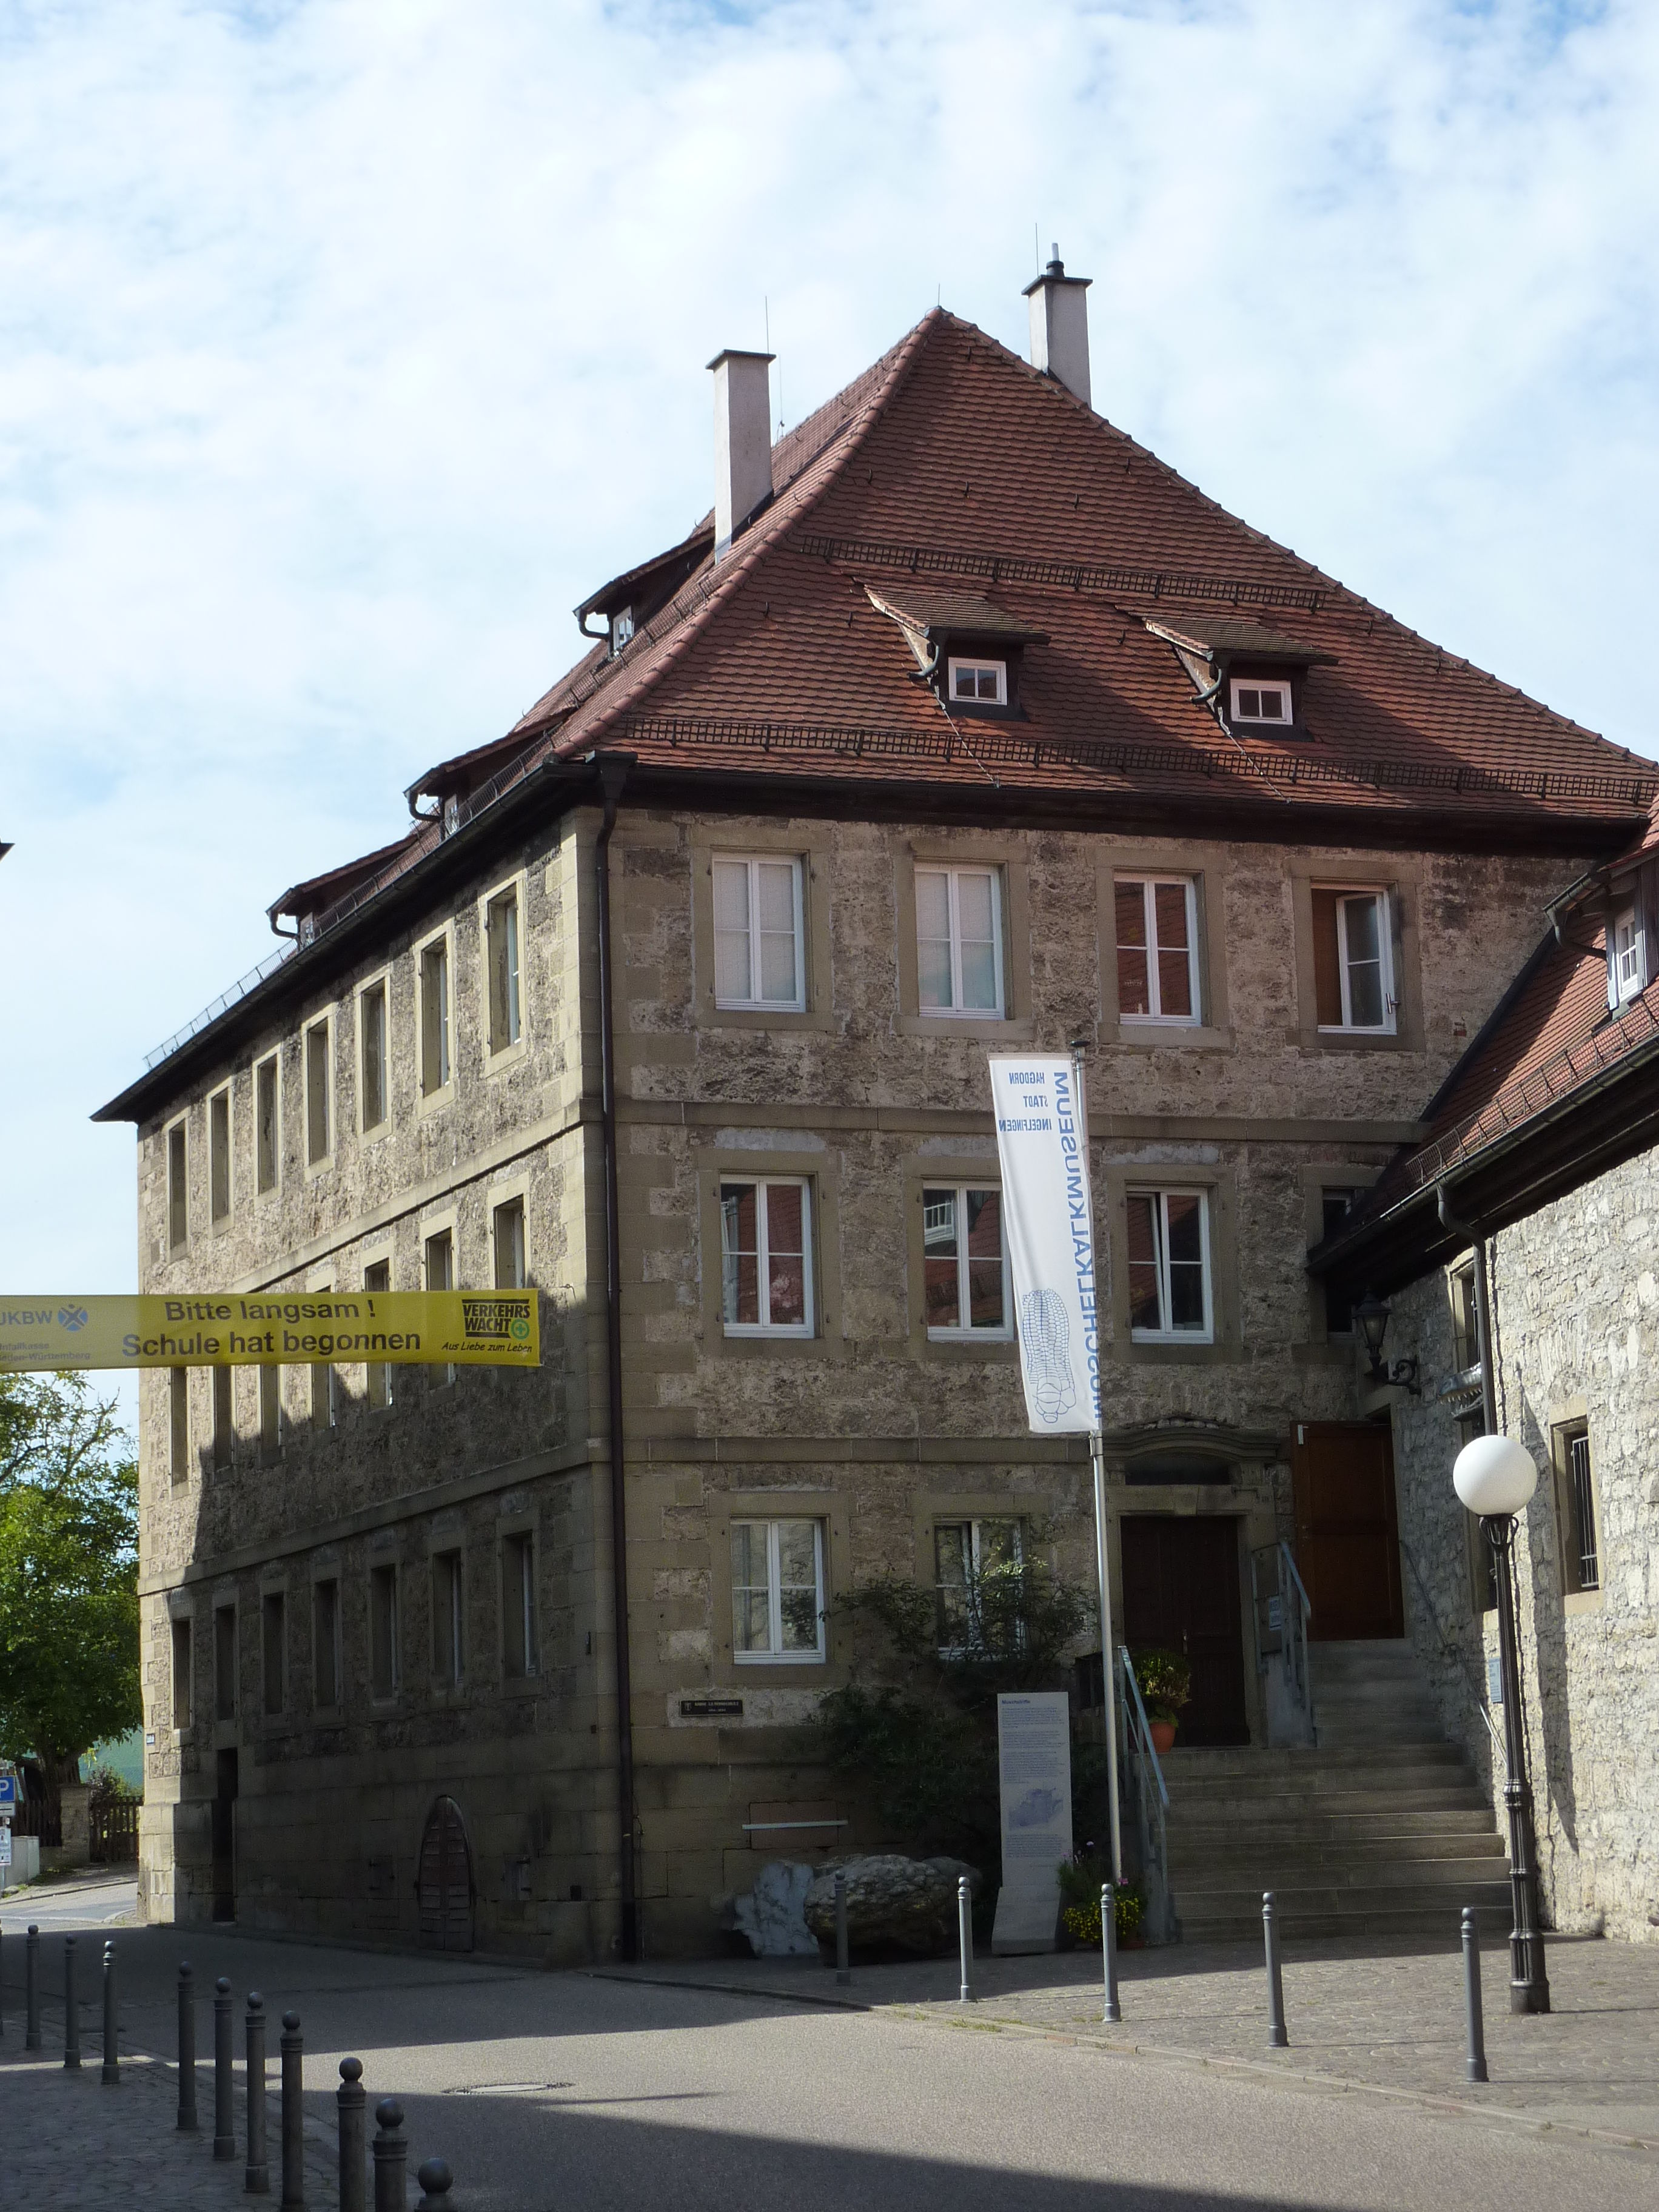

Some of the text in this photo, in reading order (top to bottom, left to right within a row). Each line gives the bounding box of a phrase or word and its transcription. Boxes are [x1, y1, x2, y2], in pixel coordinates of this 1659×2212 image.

[165, 1299, 375, 1324] Bitte langsam !
[463, 1304, 531, 1318] VERKEHRS
[464, 1317, 511, 1332] WACHT
[0, 1342, 49, 1351] nfallkasse
[122, 1330, 421, 1356] Schule hat begonnen
[441, 1342, 532, 1352] Aus Liebe zum Leben
[0, 1352, 90, 1362] aden-Württemberg
